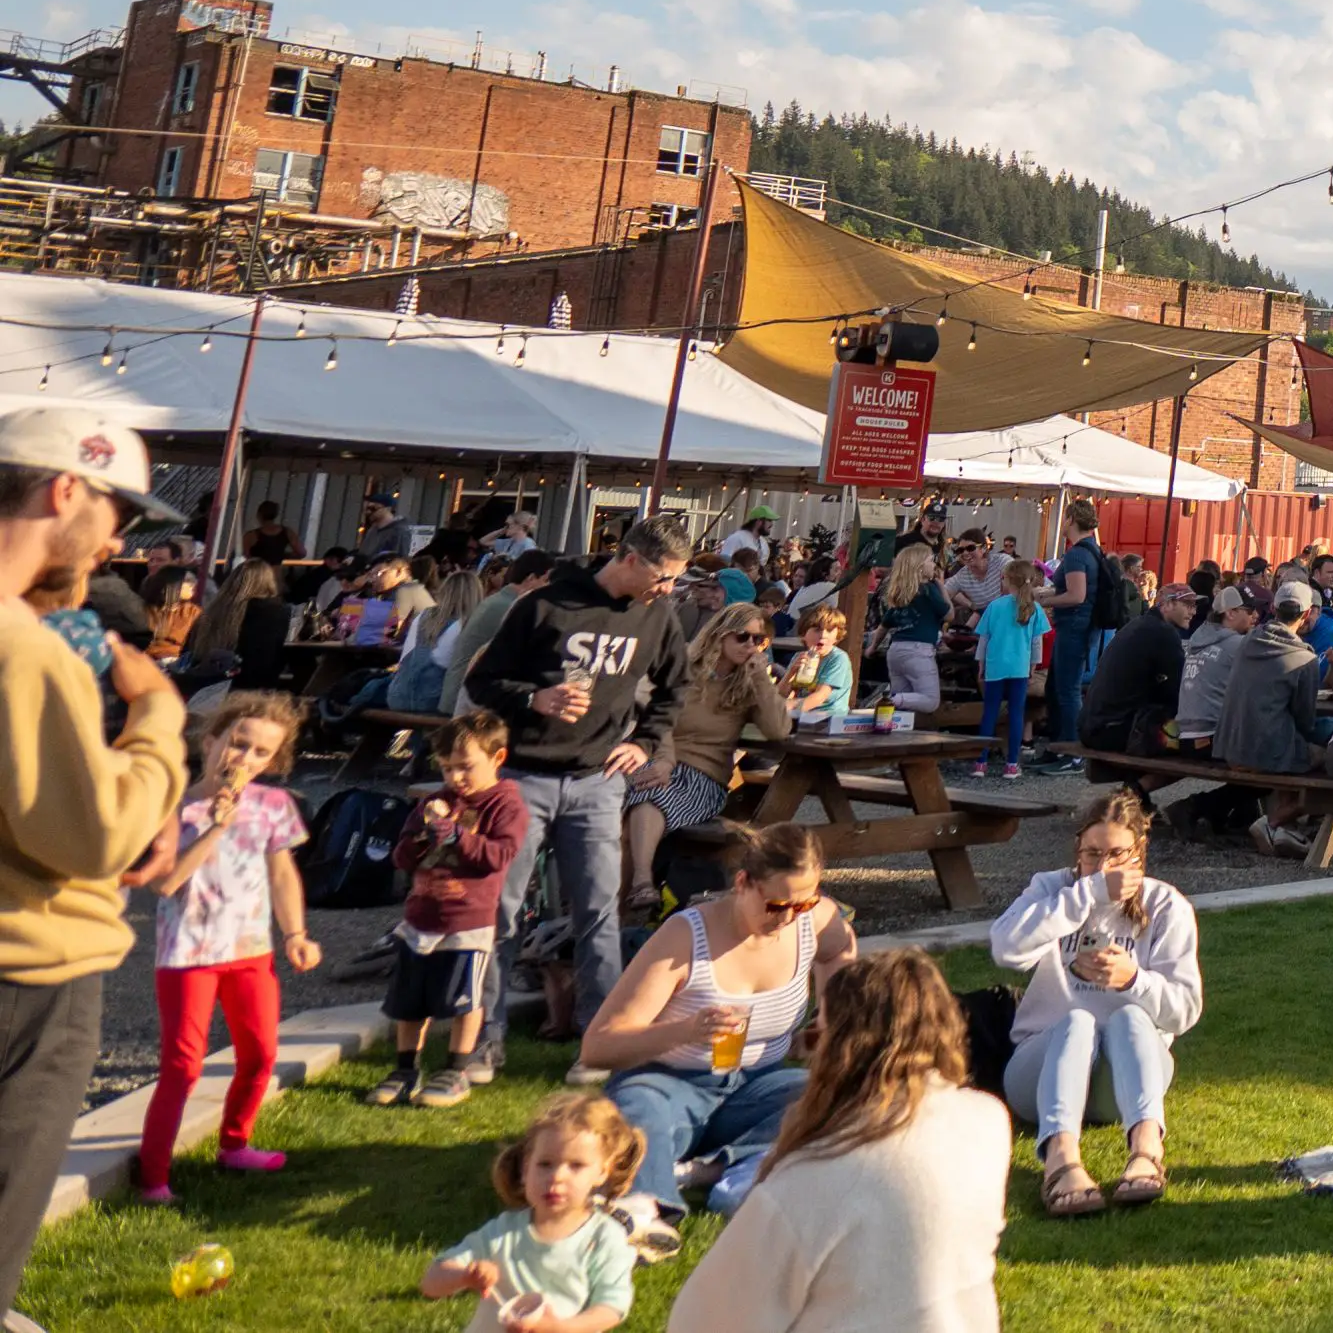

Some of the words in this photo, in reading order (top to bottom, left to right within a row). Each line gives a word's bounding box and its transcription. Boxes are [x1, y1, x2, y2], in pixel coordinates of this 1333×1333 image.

[853, 385, 919, 410] WELCOME!
[884, 419, 905, 427] RULES
[881, 432, 909, 440] WELCOME
[883, 463, 912, 471] WELCOME
[562, 632, 639, 675] SKI
